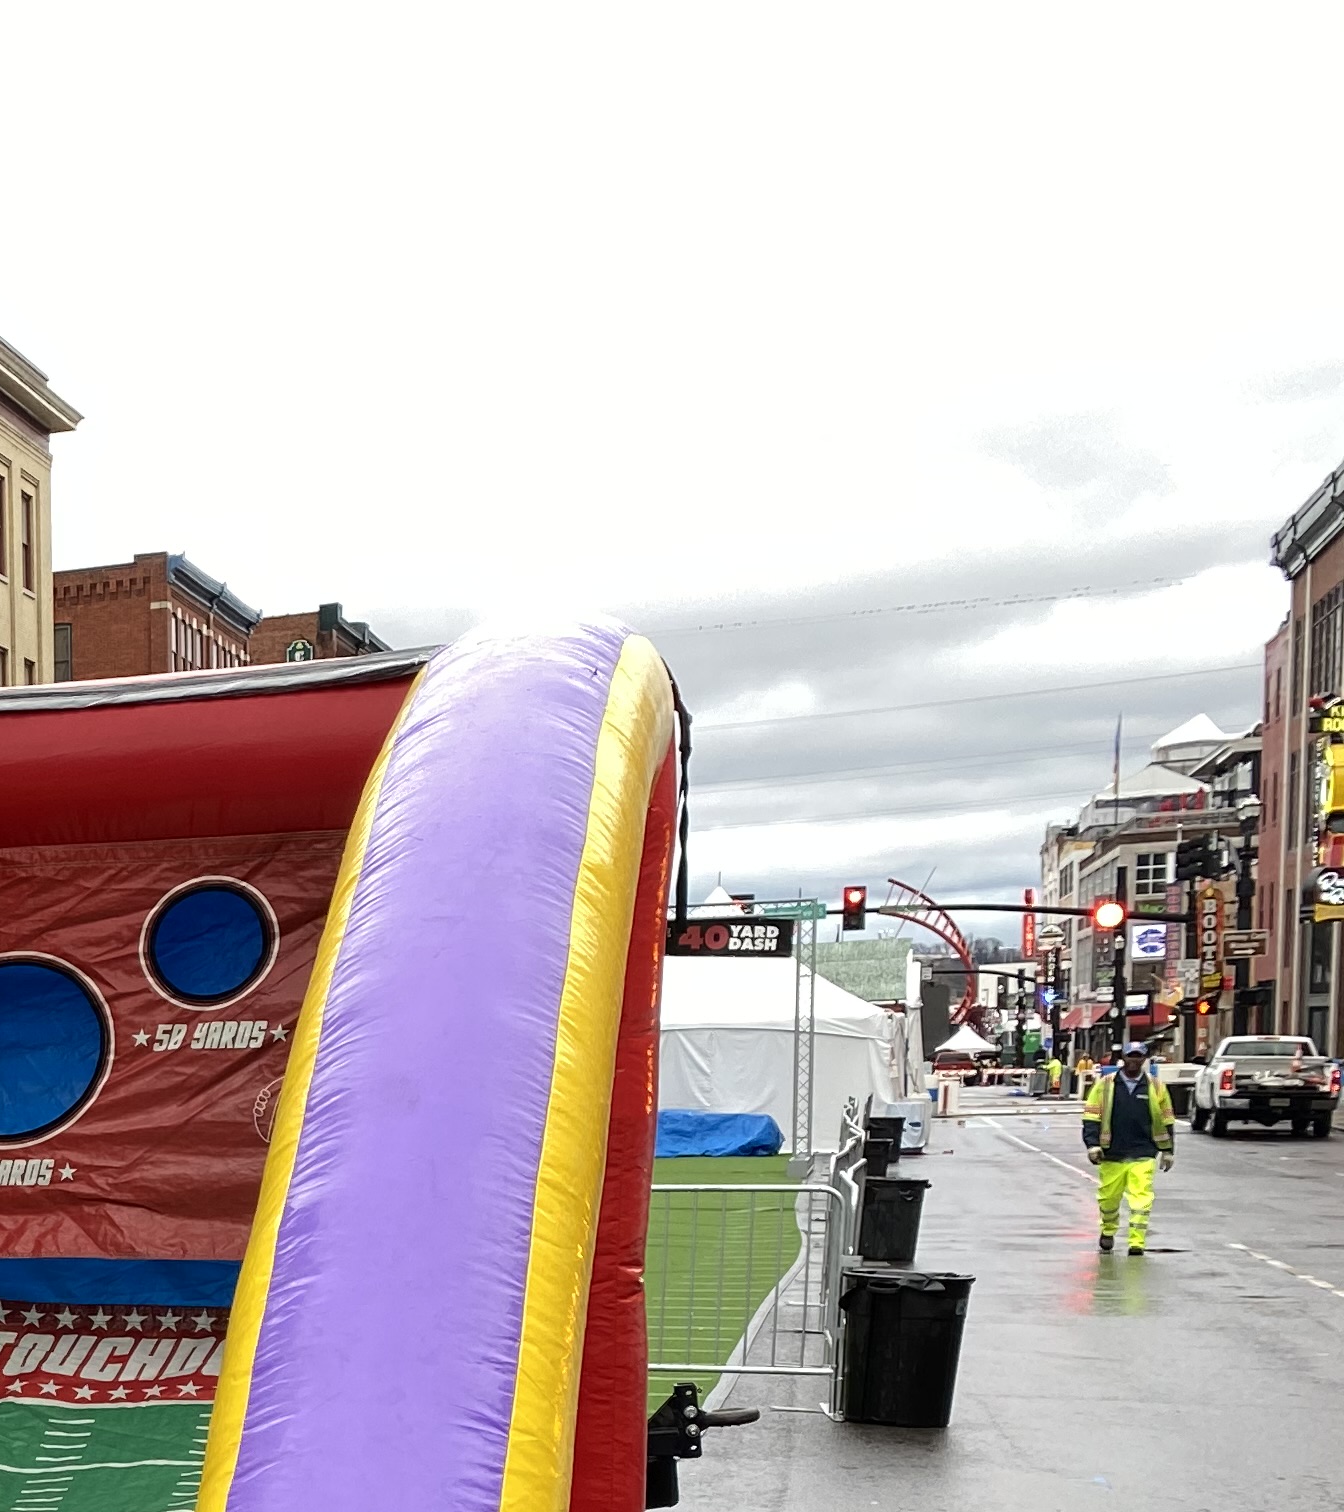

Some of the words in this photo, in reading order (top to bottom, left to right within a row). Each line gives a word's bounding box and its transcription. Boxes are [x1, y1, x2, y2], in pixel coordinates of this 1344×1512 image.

[678, 924, 729, 950] 40
[729, 924, 780, 939] YARD
[727, 937, 778, 951] DASH
[1202, 898, 1218, 975] BOOTS
[153, 1023, 188, 1051] 50
[190, 1021, 268, 1050] YARDS
